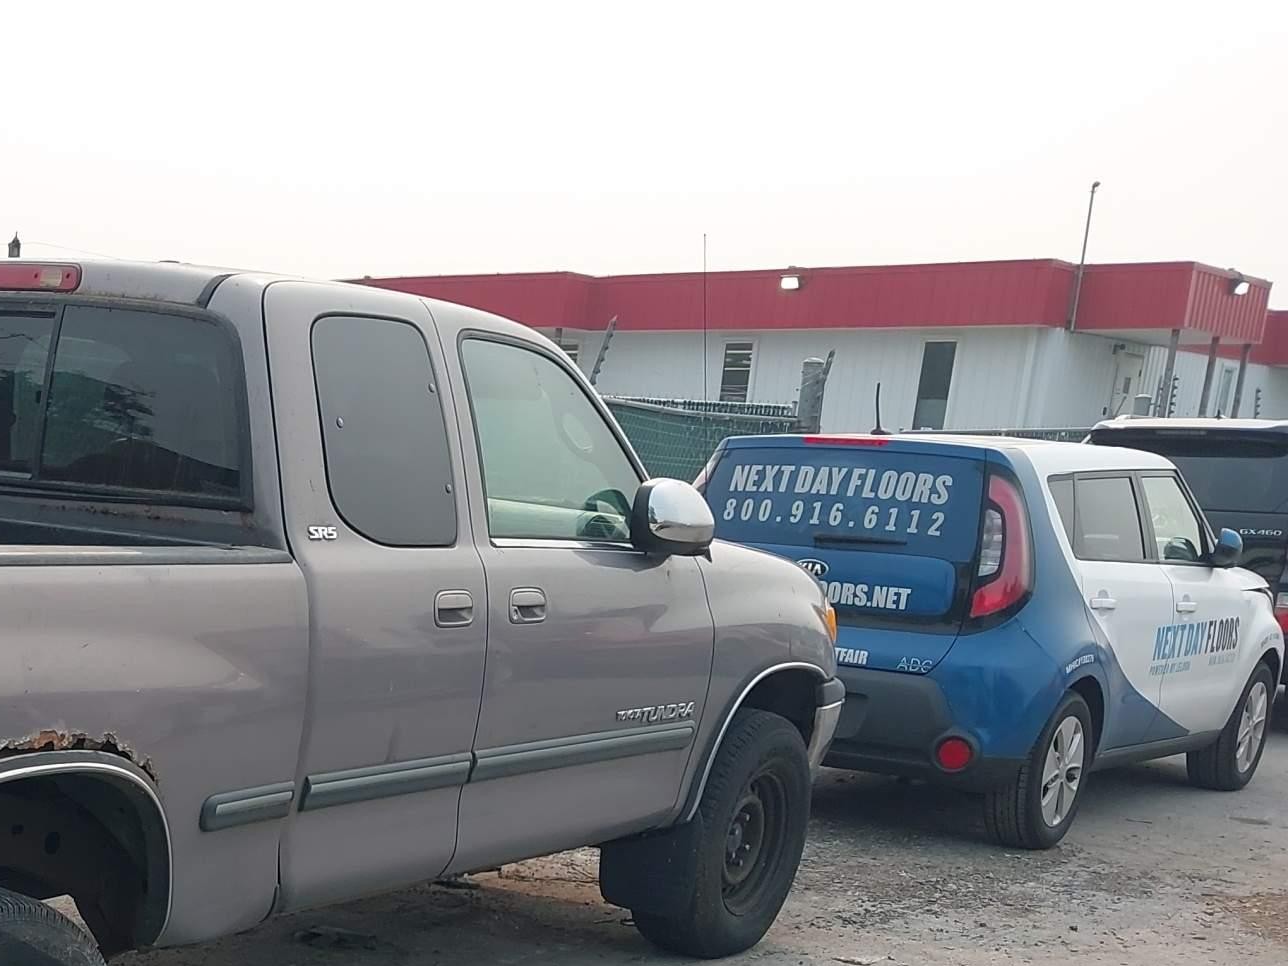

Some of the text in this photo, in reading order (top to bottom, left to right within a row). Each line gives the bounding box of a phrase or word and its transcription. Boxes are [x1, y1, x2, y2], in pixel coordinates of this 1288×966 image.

[729, 465, 953, 505] NEXT DAY FLOORS
[308, 526, 337, 539] SR5
[723, 498, 945, 536] 800.916.6112
[1152, 624, 1187, 662] NEXT
[1185, 621, 1208, 656] DAY
[1205, 616, 1240, 654] FLOORS
[642, 702, 695, 721] TUNDRA
